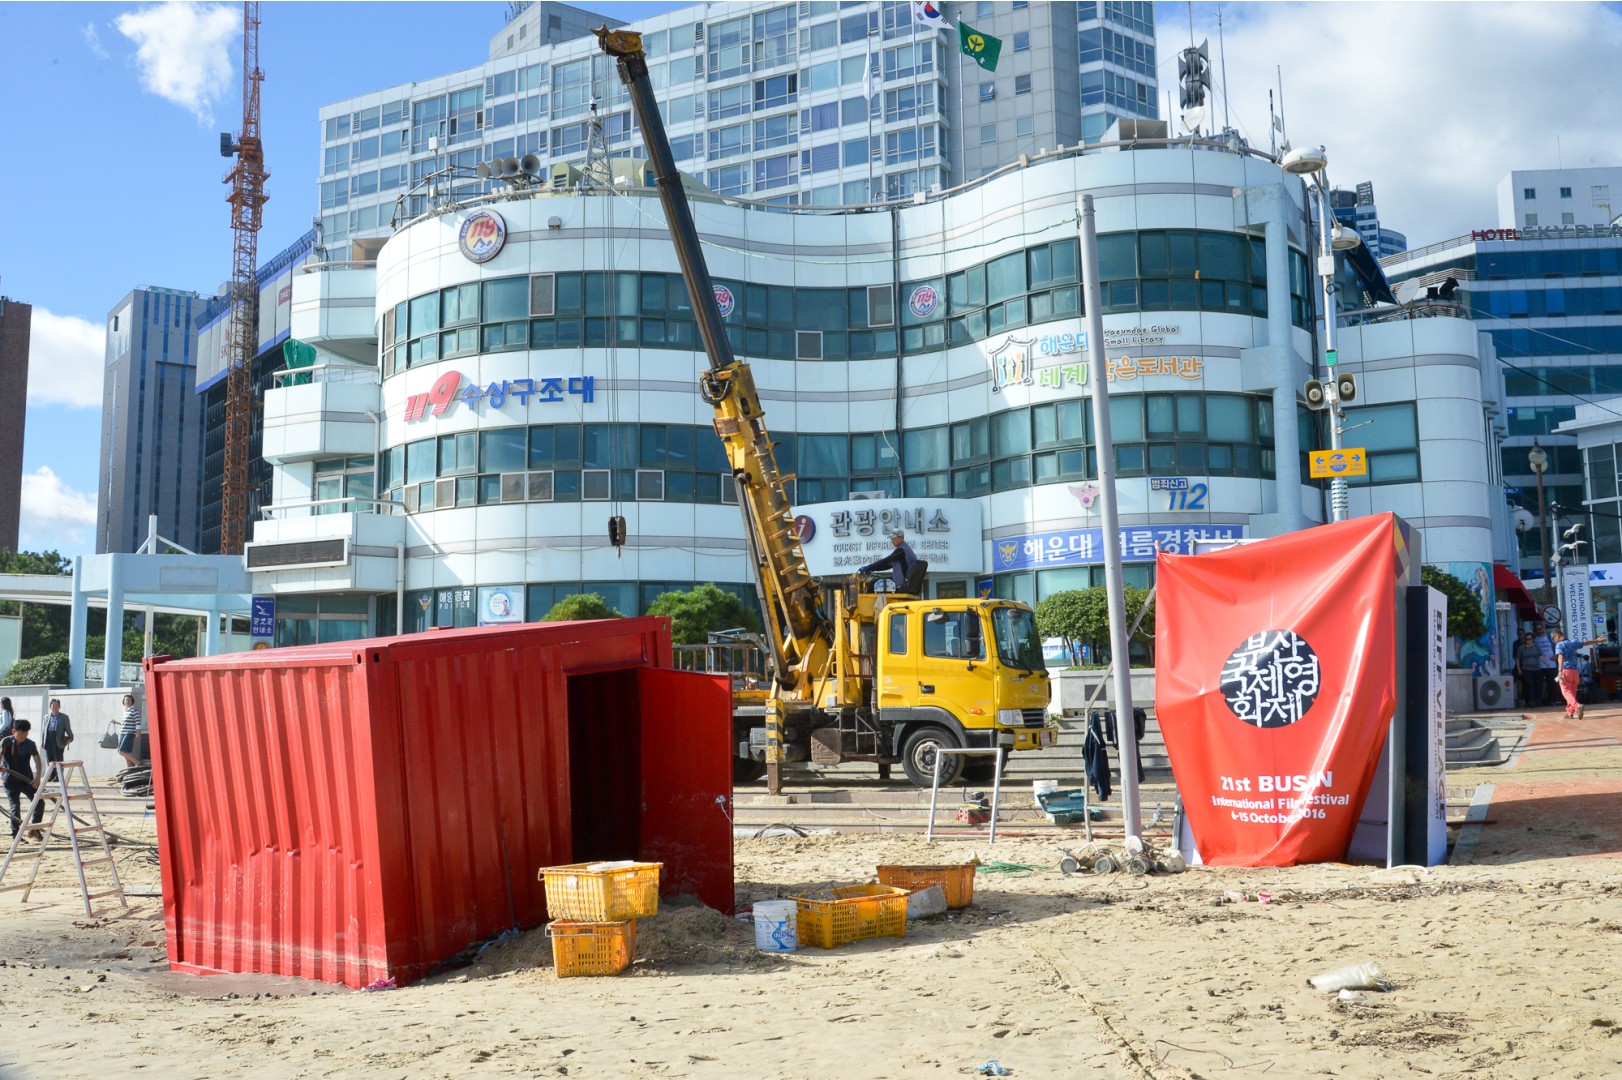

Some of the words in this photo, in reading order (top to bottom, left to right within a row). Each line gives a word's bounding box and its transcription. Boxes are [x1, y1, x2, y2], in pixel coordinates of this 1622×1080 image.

[470, 216, 496, 238] 119
[1472, 228, 1520, 241] HOTEL
[917, 289, 934, 303] 119
[1151, 325, 1180, 334] Global
[1104, 338, 1129, 346] Small
[1132, 336, 1164, 344] Library
[1039, 363, 1087, 388] 세계
[404, 370, 461, 423] 119
[461, 376, 594, 411] 수상구조대
[1151, 478, 1188, 490] 범죄신고
[1168, 482, 1208, 510] 112
[830, 507, 951, 538] 관광안내소
[833, 542, 862, 553] TOURIST
[921, 539, 950, 550] CENTER
[1023, 532, 1092, 564] 해운대
[439, 601, 470, 609] POLICE
[1569, 583, 1578, 623] WELCOMES
[1577, 582, 1587, 621] HAEUNDAE
[1580, 622, 1588, 642] BEAC
[1226, 689, 1304, 728] 화제
[1436, 689, 1446, 820] VILLAGE
[1220, 775, 1252, 792] 21st
[1211, 795, 1275, 810] International
[1250, 811, 1296, 824] Octobe
